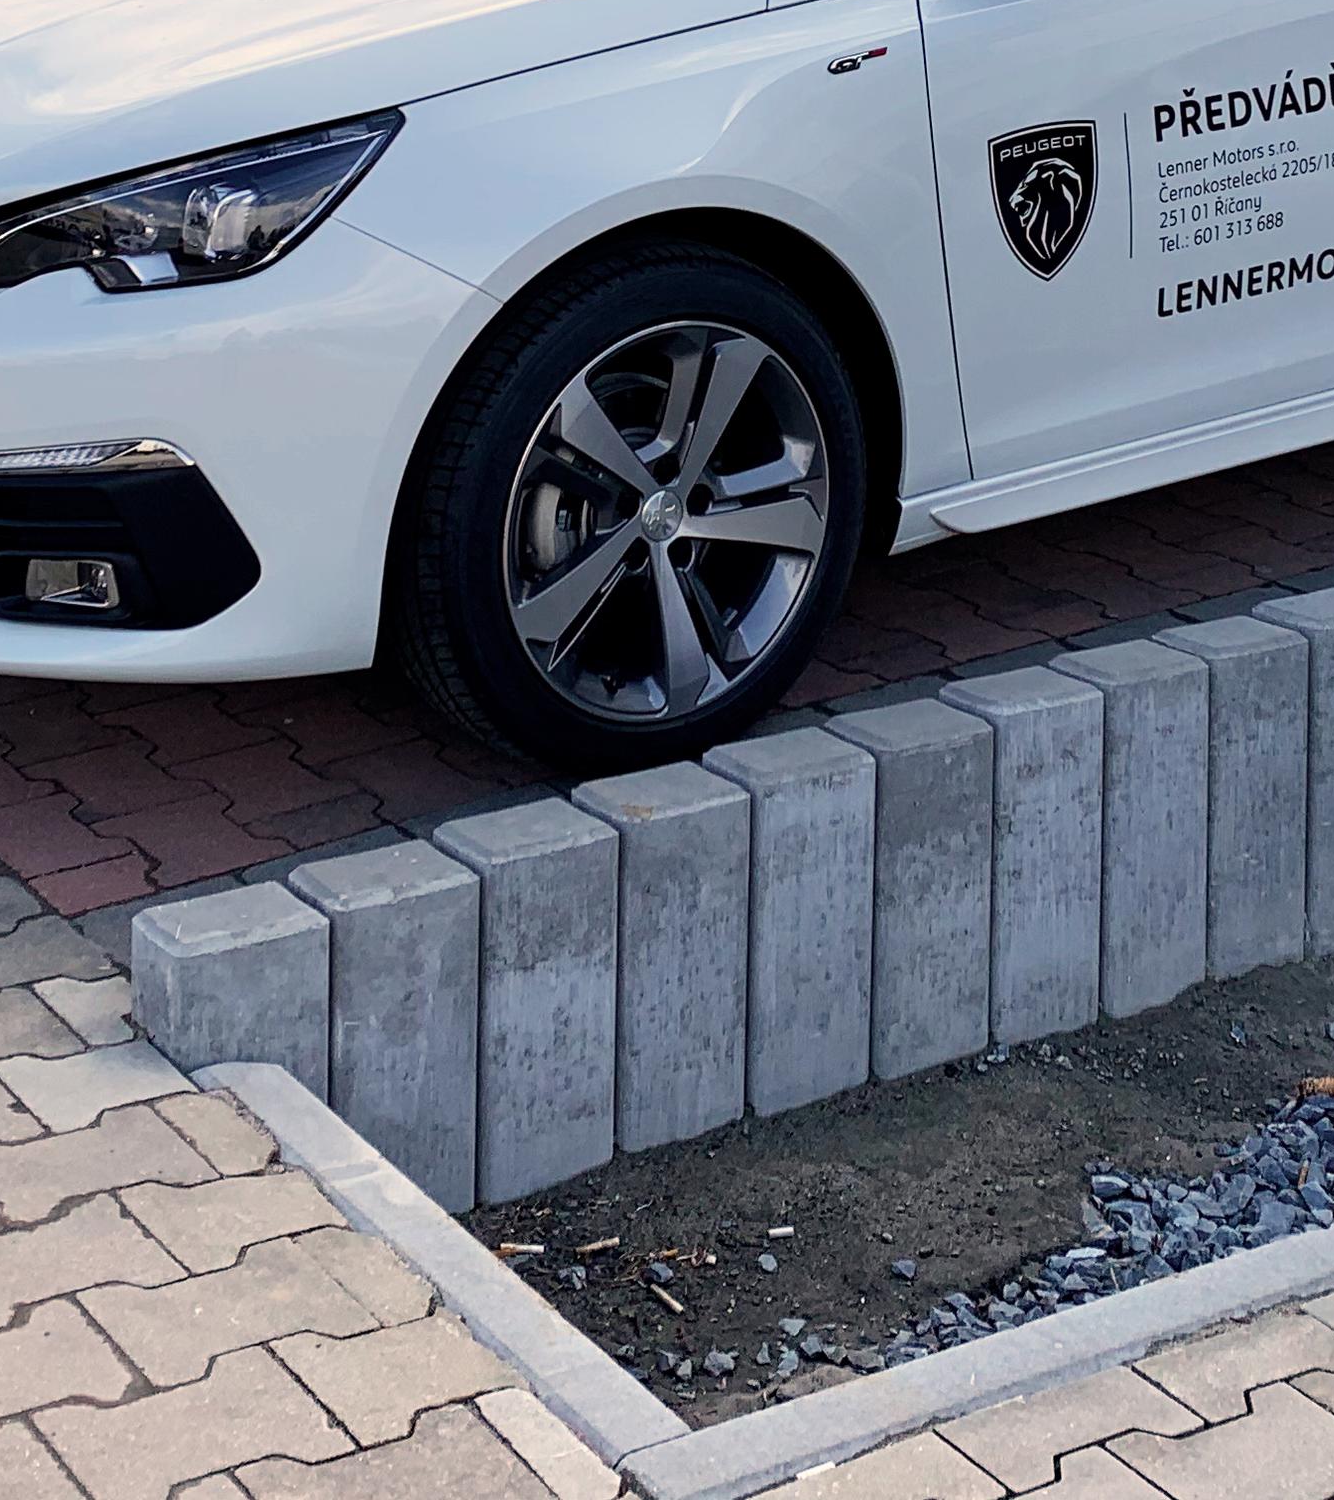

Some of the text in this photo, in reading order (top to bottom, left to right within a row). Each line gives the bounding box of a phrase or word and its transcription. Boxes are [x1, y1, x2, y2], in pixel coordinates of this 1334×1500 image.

[999, 135, 1086, 162] PEUGEOT
[1157, 140, 1300, 178] Lenner Motors s.r.o.
[1158, 164, 1277, 203] Černokostelecká
[1159, 196, 1263, 229] 251 01 Říčany
[1159, 211, 1284, 253] Tel.: 601 313 688
